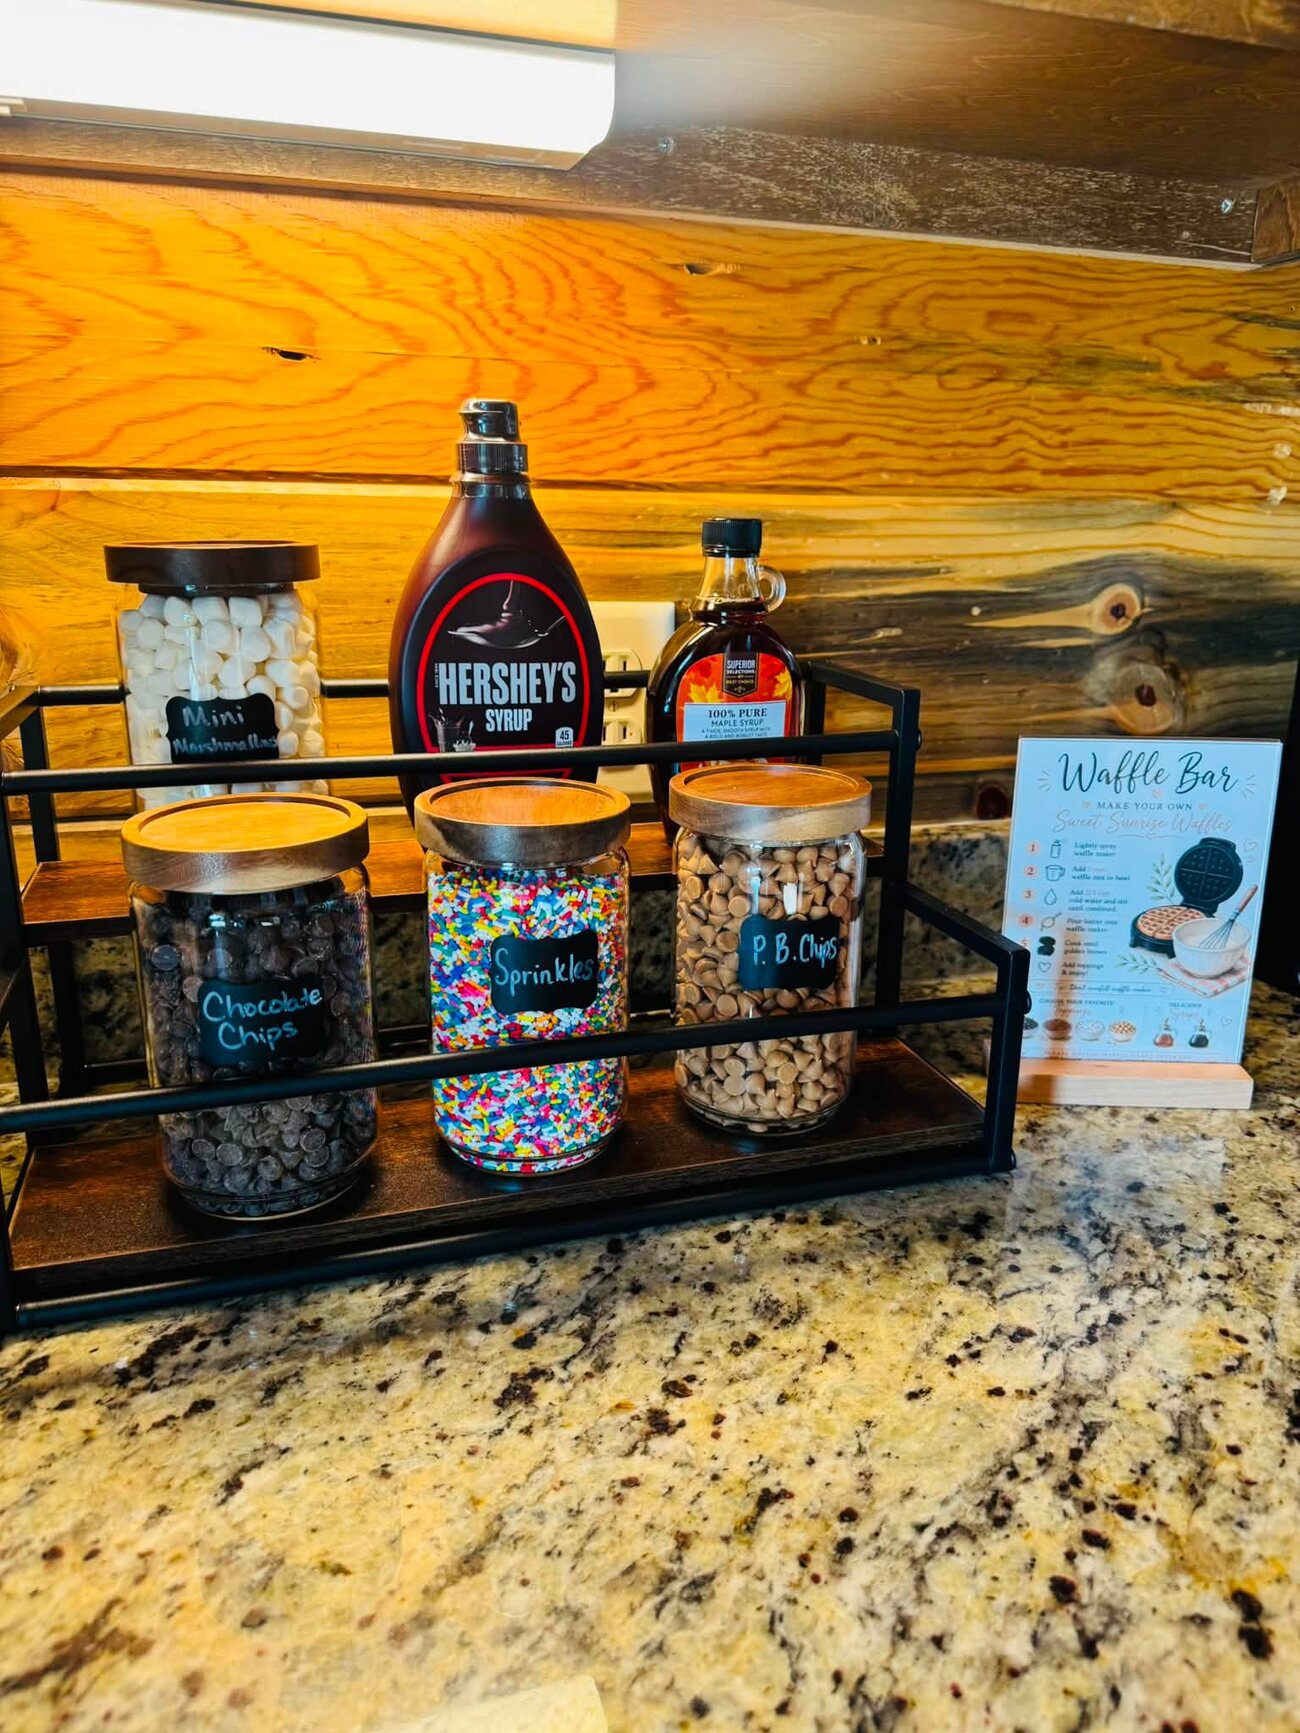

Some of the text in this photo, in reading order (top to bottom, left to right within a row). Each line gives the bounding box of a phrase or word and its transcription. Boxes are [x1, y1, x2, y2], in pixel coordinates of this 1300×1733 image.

[726, 659, 756, 669] SUPERIOR
[439, 661, 576, 705] HERSHEY'S
[182, 705, 244, 727] Mini
[708, 708, 768, 719] 100% PURE
[485, 708, 533, 732] SYRUP
[711, 718, 764, 727] MAPLE SYRUP
[559, 729, 570, 740] 45
[1058, 750, 1239, 794] Waffle Bar
[1097, 801, 1193, 811] MAKE YOUR OWN
[1053, 810, 1232, 835] Sweet Sunrise Waffles
[1074, 840, 1097, 850] Lightly
[1027, 867, 1034, 876] 2
[1024, 890, 1032, 899] 3
[1022, 916, 1029, 925] 4
[495, 947, 594, 997] Sprinkles
[202, 987, 323, 1022] Chocolate
[218, 1021, 298, 1051] Chips
